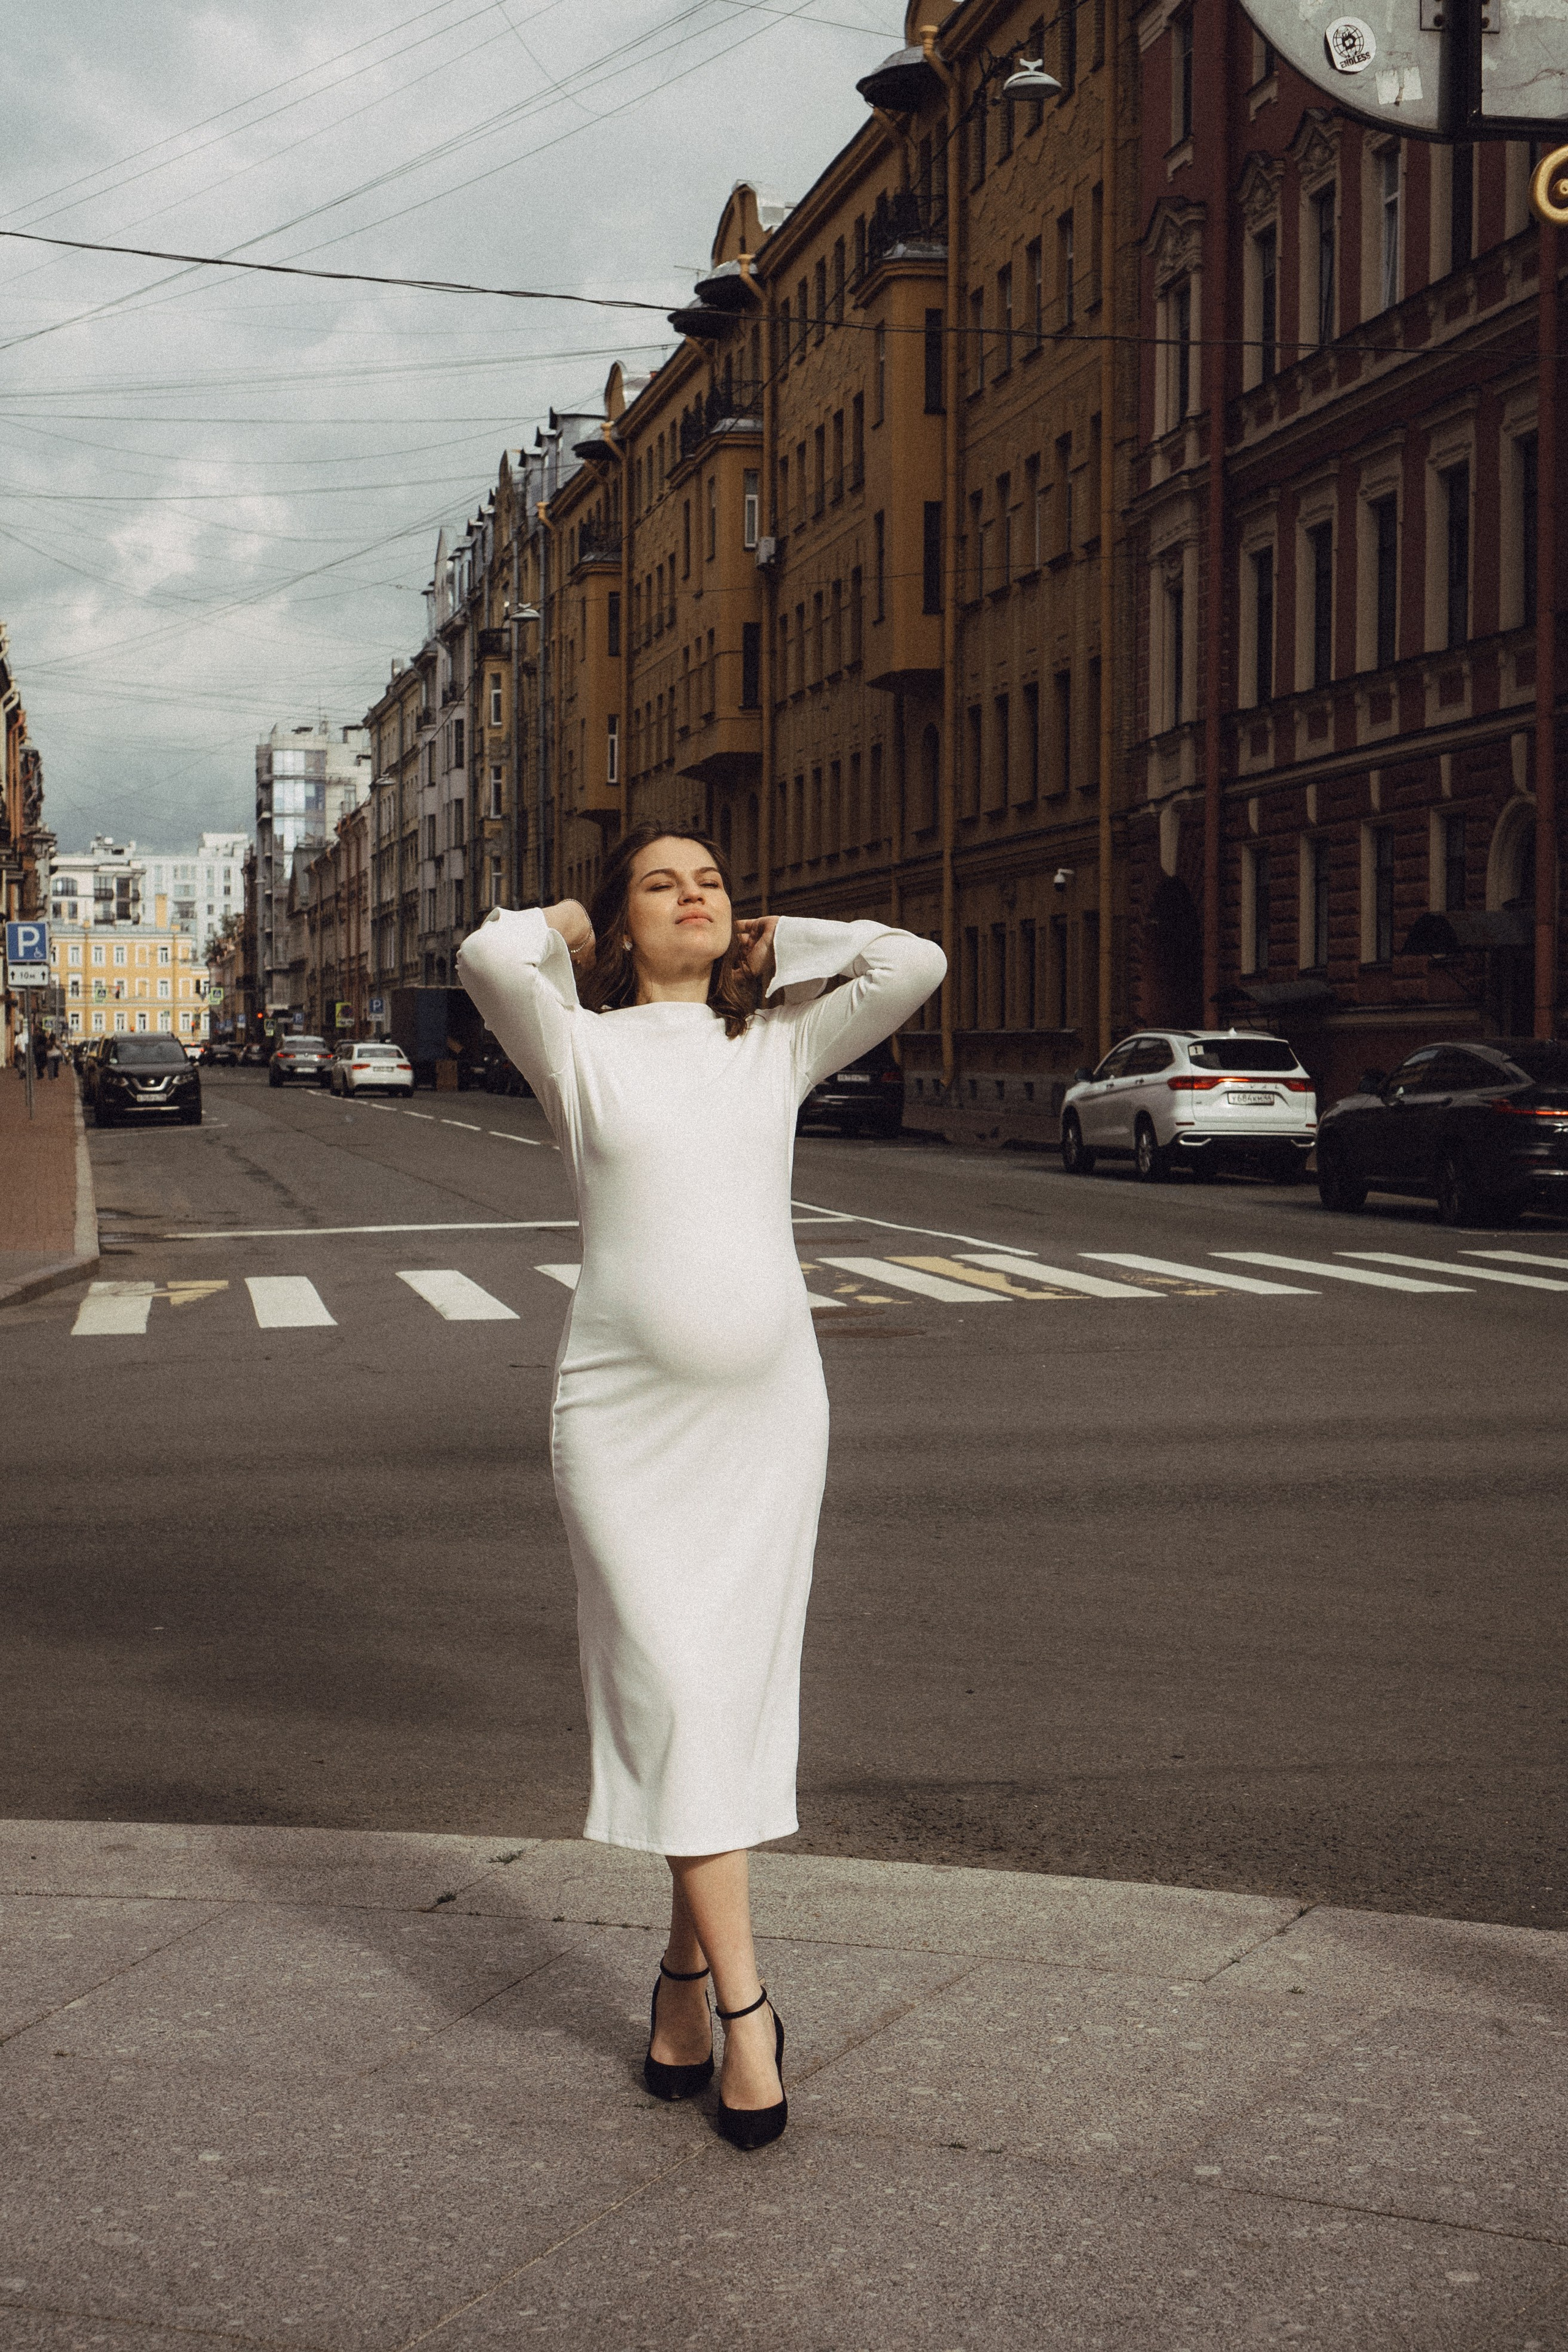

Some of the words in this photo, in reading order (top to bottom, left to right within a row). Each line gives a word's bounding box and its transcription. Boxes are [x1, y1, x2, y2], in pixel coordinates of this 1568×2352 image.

[1340, 51, 1371, 68] ENDLESS
[18, 926, 40, 957] P
[373, 999, 381, 1011] P
